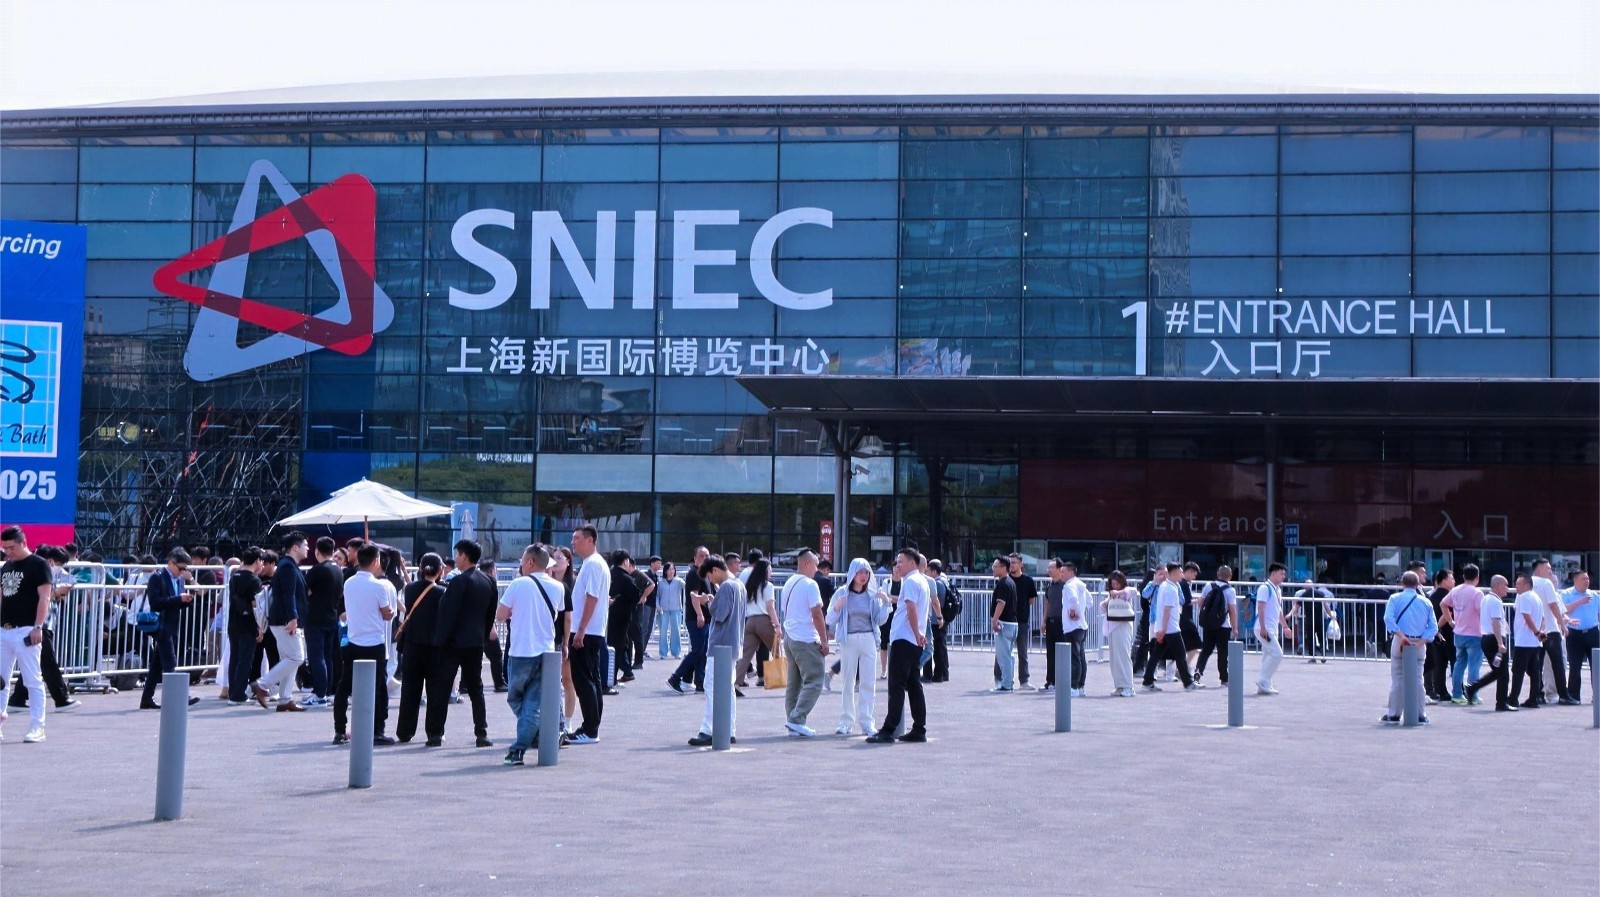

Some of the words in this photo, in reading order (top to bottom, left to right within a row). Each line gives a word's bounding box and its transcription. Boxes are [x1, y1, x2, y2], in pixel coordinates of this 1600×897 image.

[449, 207, 833, 310] SNIEC
[1121, 301, 1147, 376] 1
[1166, 299, 1397, 335] #ENTRANCE
[1410, 299, 1506, 335] HALL
[446, 337, 830, 376] 上海新国际博览中心
[1200, 340, 1331, 377] 入口厅
[7, 423, 47, 445] Bath
[1153, 508, 1284, 532] Entrance
[1432, 509, 1508, 542] 入口
